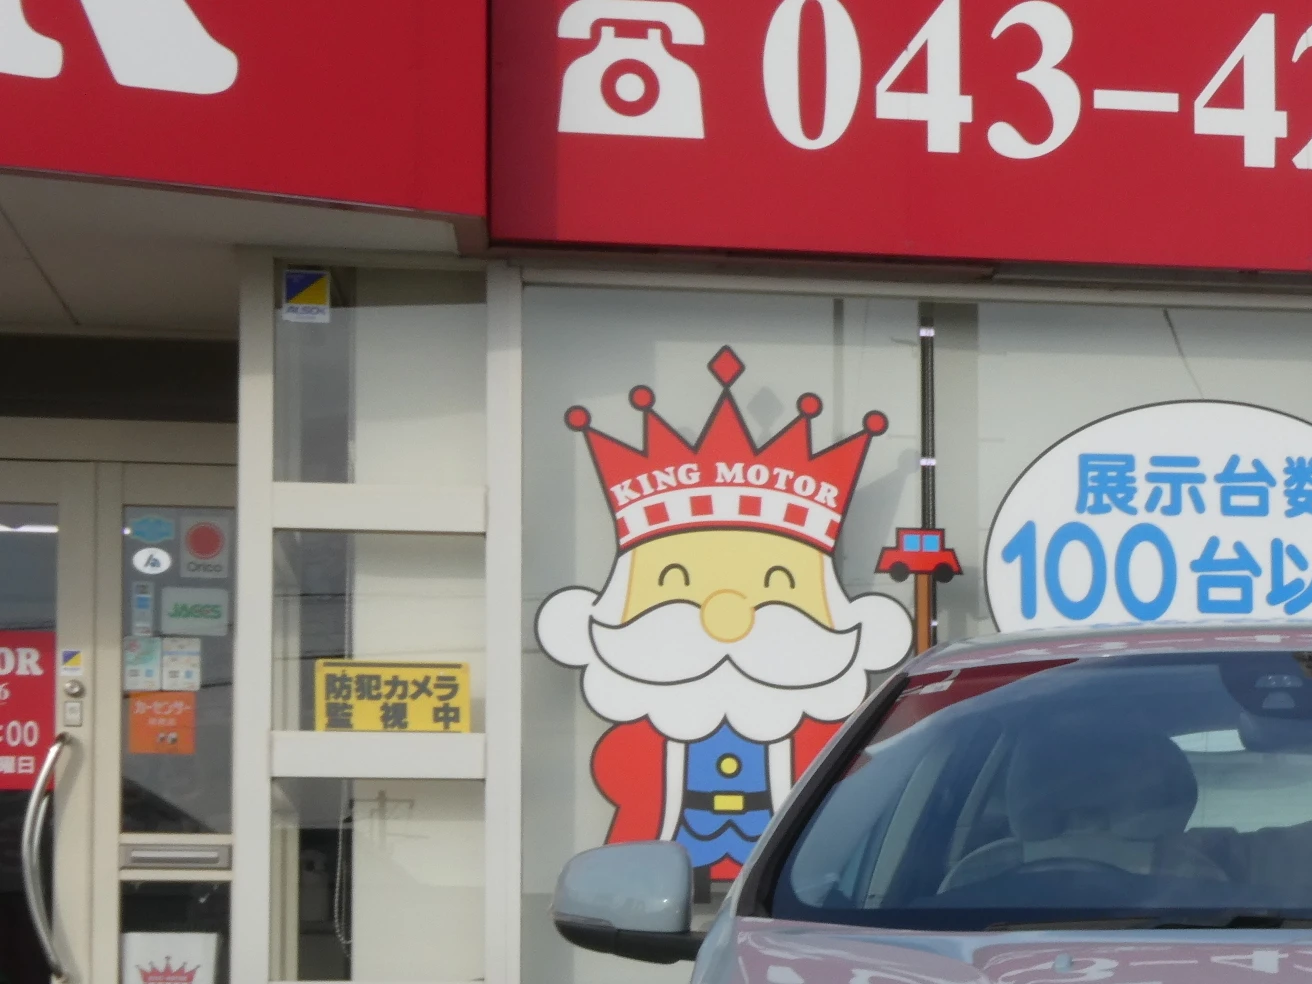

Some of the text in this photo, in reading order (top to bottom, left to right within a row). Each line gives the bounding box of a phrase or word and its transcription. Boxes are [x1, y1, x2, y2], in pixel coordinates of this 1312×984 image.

[609, 461, 840, 509] KING MOTOR
[324, 669, 461, 702] 防犯カメラ
